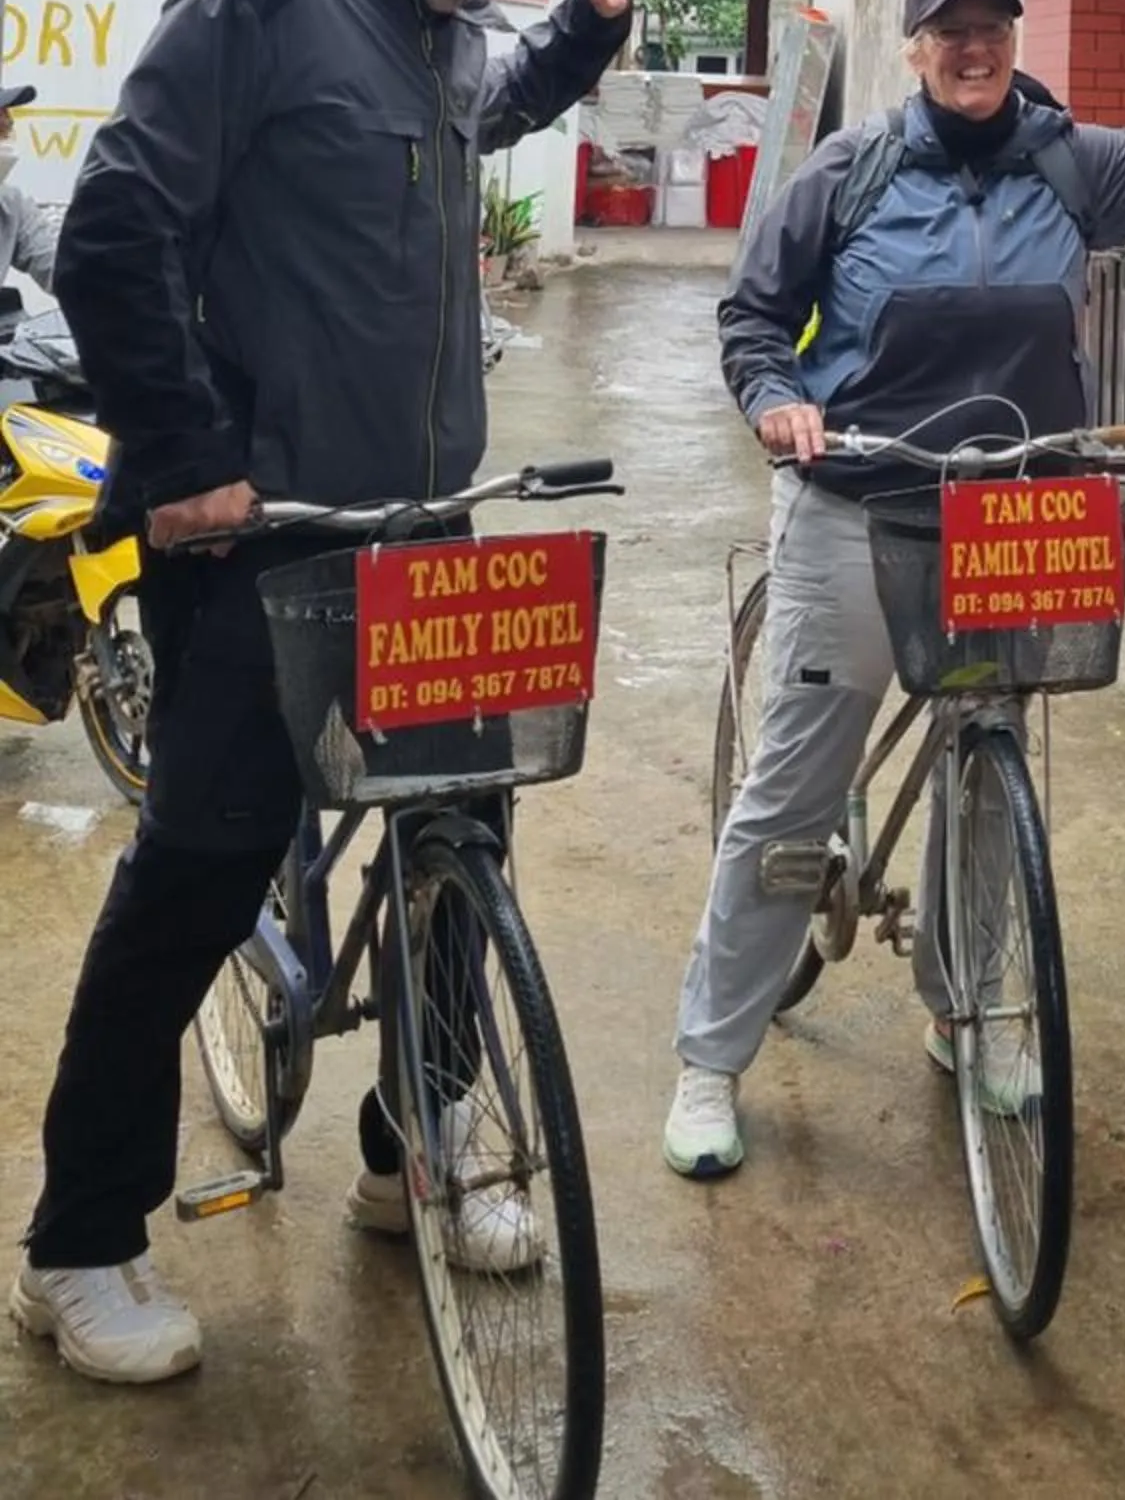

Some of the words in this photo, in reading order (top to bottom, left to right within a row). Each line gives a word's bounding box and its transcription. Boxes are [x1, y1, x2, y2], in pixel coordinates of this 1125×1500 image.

[981, 491, 1034, 525] TAM
[1040, 490, 1086, 522] COC
[408, 556, 479, 599] TAM
[487, 549, 548, 590] COC
[952, 538, 1039, 579] FAMILY
[1045, 536, 1115, 574] HOTEL
[988, 591, 1024, 613] 094
[1030, 588, 1065, 611] 367
[1071, 586, 1115, 608] 7874
[368, 612, 482, 668] FAMILY
[491, 602, 583, 654] HOTEL
[416, 678, 463, 707] 094
[471, 671, 517, 699] 367
[524, 662, 582, 692] 7874
